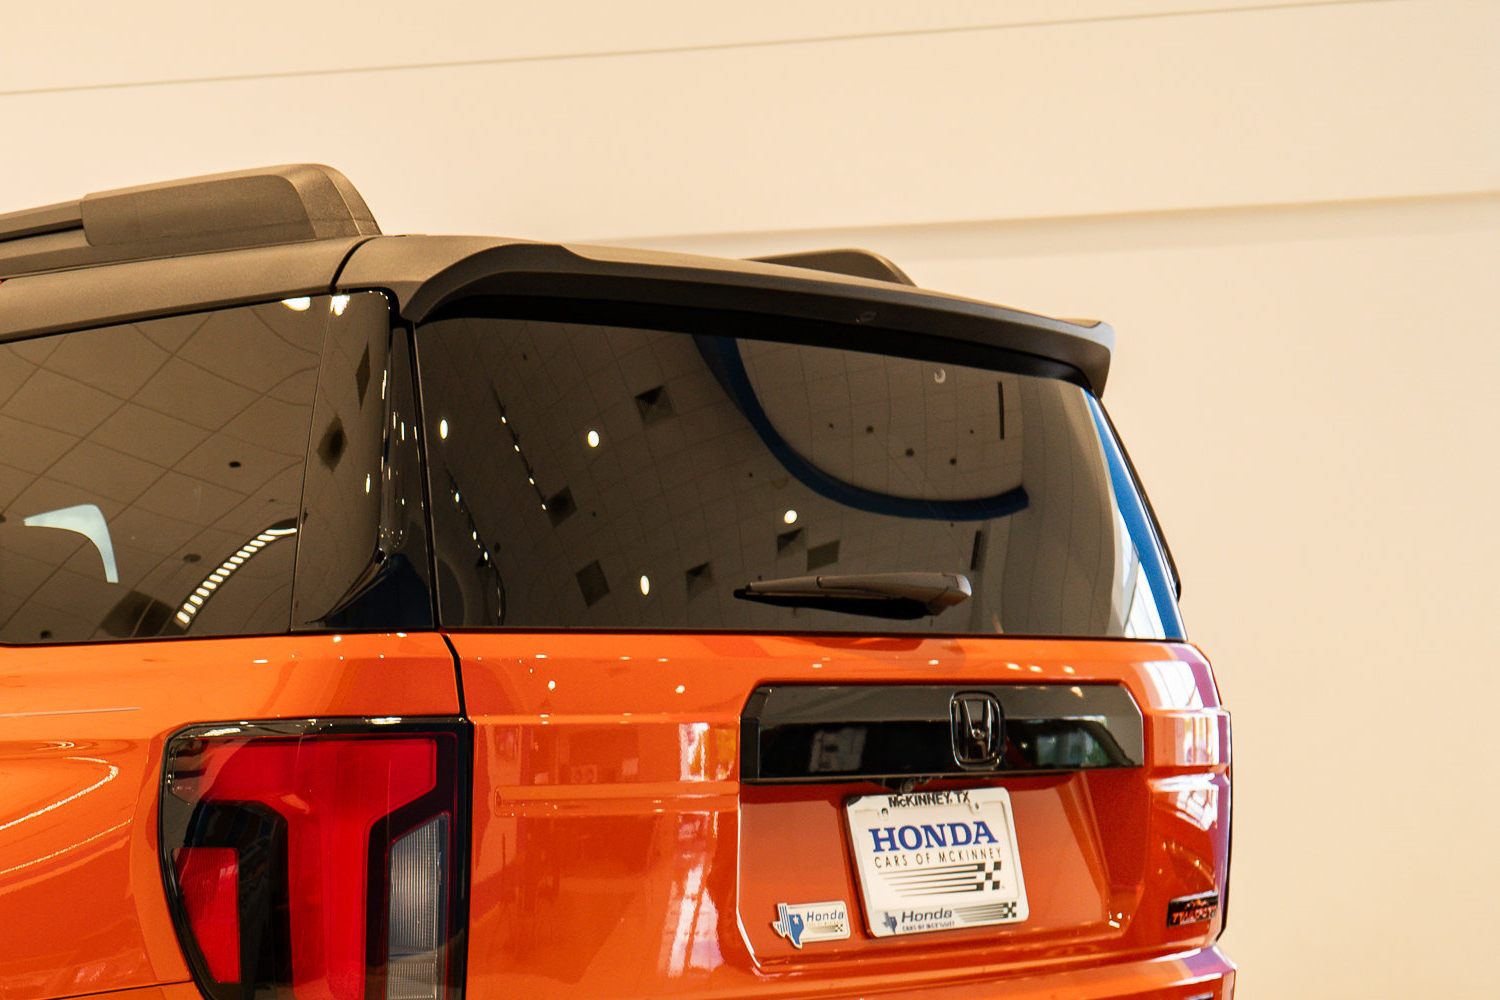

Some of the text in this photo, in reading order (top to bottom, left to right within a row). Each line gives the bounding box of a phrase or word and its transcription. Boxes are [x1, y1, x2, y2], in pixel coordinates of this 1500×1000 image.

[955, 791, 970, 804] TX
[868, 821, 998, 853] HONDA
[874, 847, 1002, 869] CARS OF MCKINNEY
[806, 910, 844, 922] Honda
[901, 907, 953, 923] Honda
